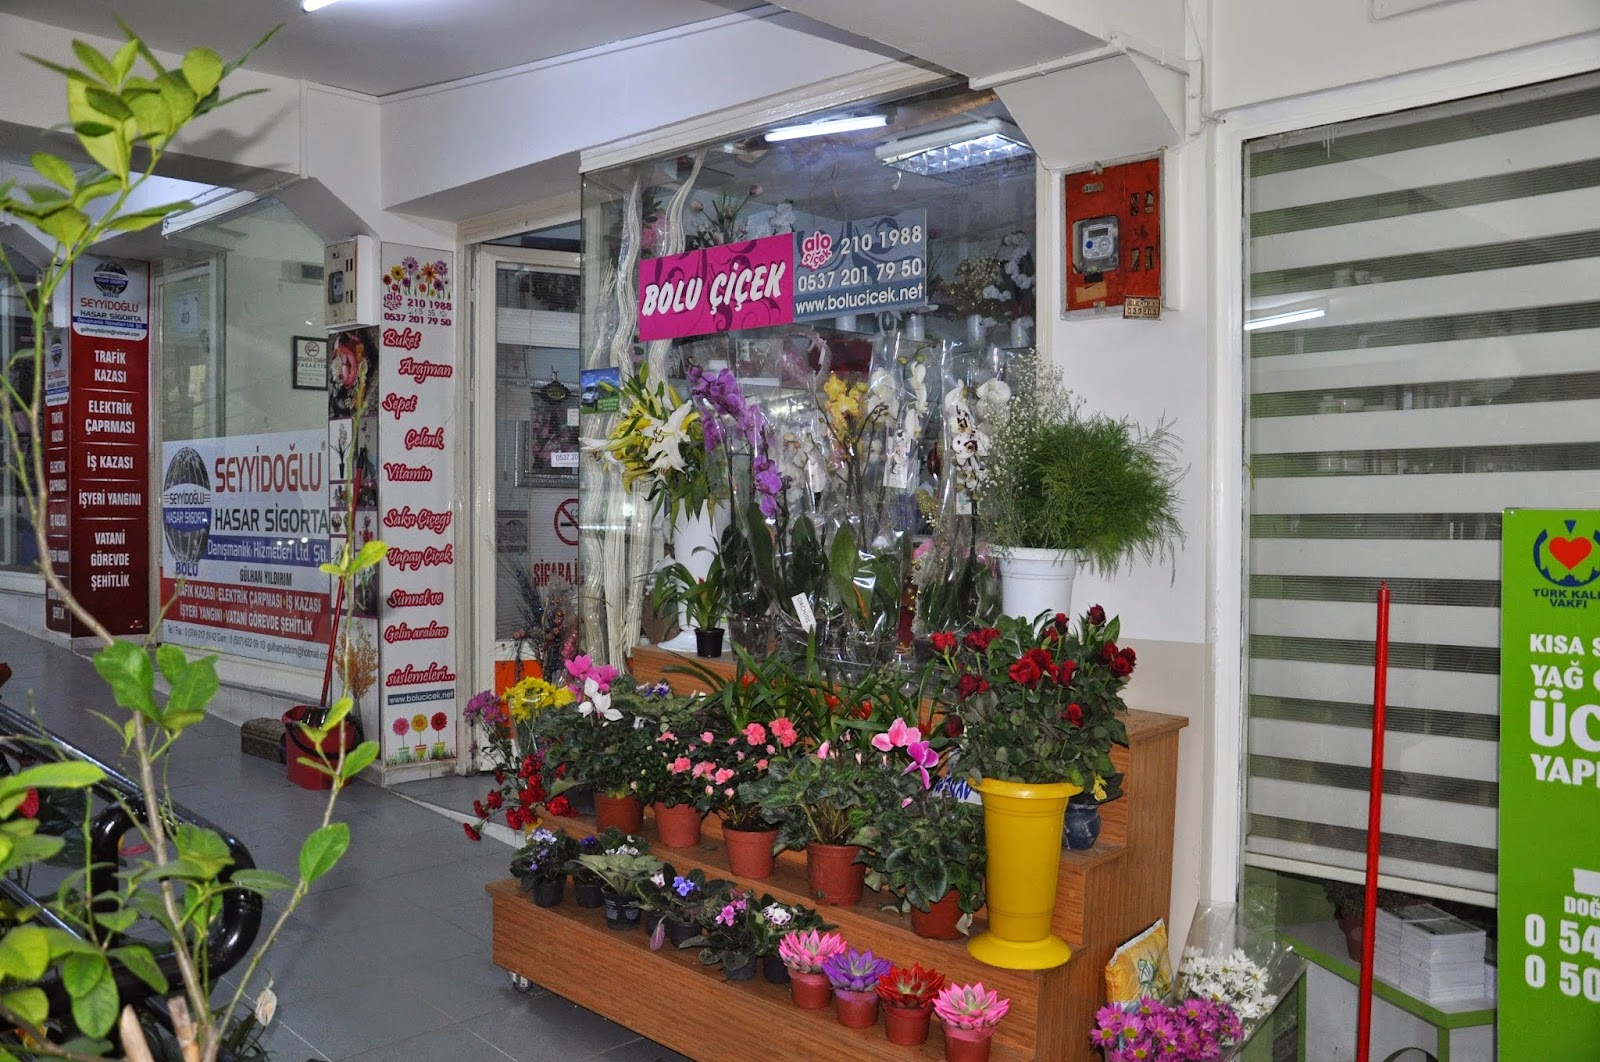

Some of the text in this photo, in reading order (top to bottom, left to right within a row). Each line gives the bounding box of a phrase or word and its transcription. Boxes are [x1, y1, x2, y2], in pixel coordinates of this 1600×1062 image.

[803, 231, 832, 252] alo
[840, 225, 922, 255] 210 1988
[798, 258, 922, 292] 0537 201 79 50
[386, 292, 402, 301] alo
[641, 261, 787, 317] BOLU ÇİÇEK
[795, 283, 924, 314] www.bolucicek.net
[81, 298, 139, 313] SEYYİDOĞLU
[407, 298, 452, 311] 210 1988
[80, 310, 142, 322] HASAR SİGORTA
[384, 312, 452, 327] 0537 201 79 50
[383, 327, 421, 351] Buket
[94, 348, 126, 365] TRAFİK
[94, 369, 127, 383] KAZASI
[398, 356, 453, 384] Arajman
[88, 399, 133, 415] ELEKTRİK
[382, 392, 418, 420] Sepet
[85, 418, 136, 436] ÇAPRMASI
[404, 426, 445, 450] Çelenk
[87, 452, 134, 471] İŞ KAZASI
[555, 453, 570, 461] 0537
[214, 443, 322, 493] SEYYİDOĞLU
[383, 462, 432, 482] Vitamin
[79, 489, 142, 508] İŞYERİ YANGINI
[169, 489, 205, 505] SEYYİDOĞLU
[166, 510, 184, 524] HASAR
[215, 503, 330, 534] HASAR SİGORTA
[384, 505, 417, 529] Saksı
[94, 529, 126, 545] VATANİ
[90, 550, 130, 567] GÖREVDE
[207, 539, 251, 560] Danışmanlık
[386, 547, 422, 571] Yapay
[175, 561, 199, 577] BOLU
[239, 565, 292, 587] GÜLHAN YILDIRIM
[90, 571, 130, 591] ŞEHİTLİK
[195, 585, 216, 600] KAZASI
[218, 587, 248, 604] ELEKTRİK
[249, 591, 283, 609] ÇARPMASI
[294, 596, 321, 613] KAZASI
[387, 588, 444, 608] Sünnet ve
[1532, 587, 1568, 598] TÜRK
[1550, 598, 1587, 609] VAKFI
[179, 602, 198, 621] İŞYERİ
[225, 607, 248, 625] VATANİ
[248, 612, 280, 631] GÖREVDE
[280, 617, 313, 638] ŞEHİTLİK
[384, 622, 411, 643] Gelin
[1530, 633, 1585, 656] KISA
[1530, 660, 1584, 690] YAĞ
[389, 689, 454, 704] www.bolucicek.net
[1525, 913, 1600, 961] 0 54
[1525, 954, 1600, 1003] 0 50
